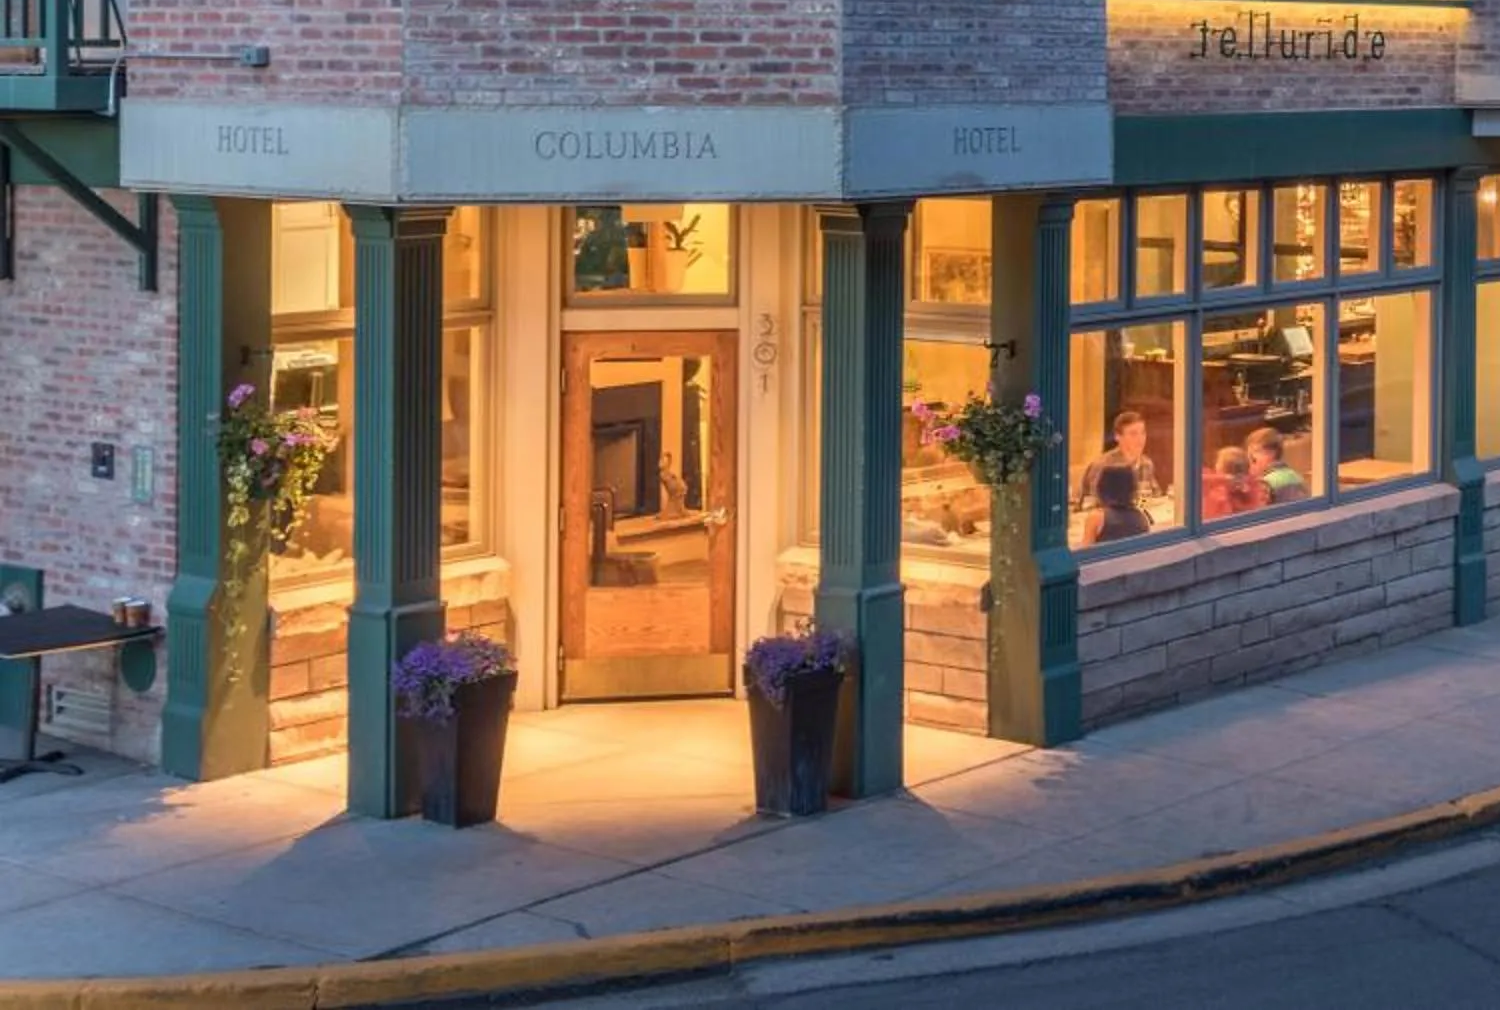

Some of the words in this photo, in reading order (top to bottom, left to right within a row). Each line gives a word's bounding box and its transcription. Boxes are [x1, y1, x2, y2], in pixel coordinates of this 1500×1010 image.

[1191, 11, 1386, 60] telluride
[217, 125, 290, 156] HOTEL
[534, 130, 718, 161] COLUMBIA
[952, 125, 1022, 156] HOTEL
